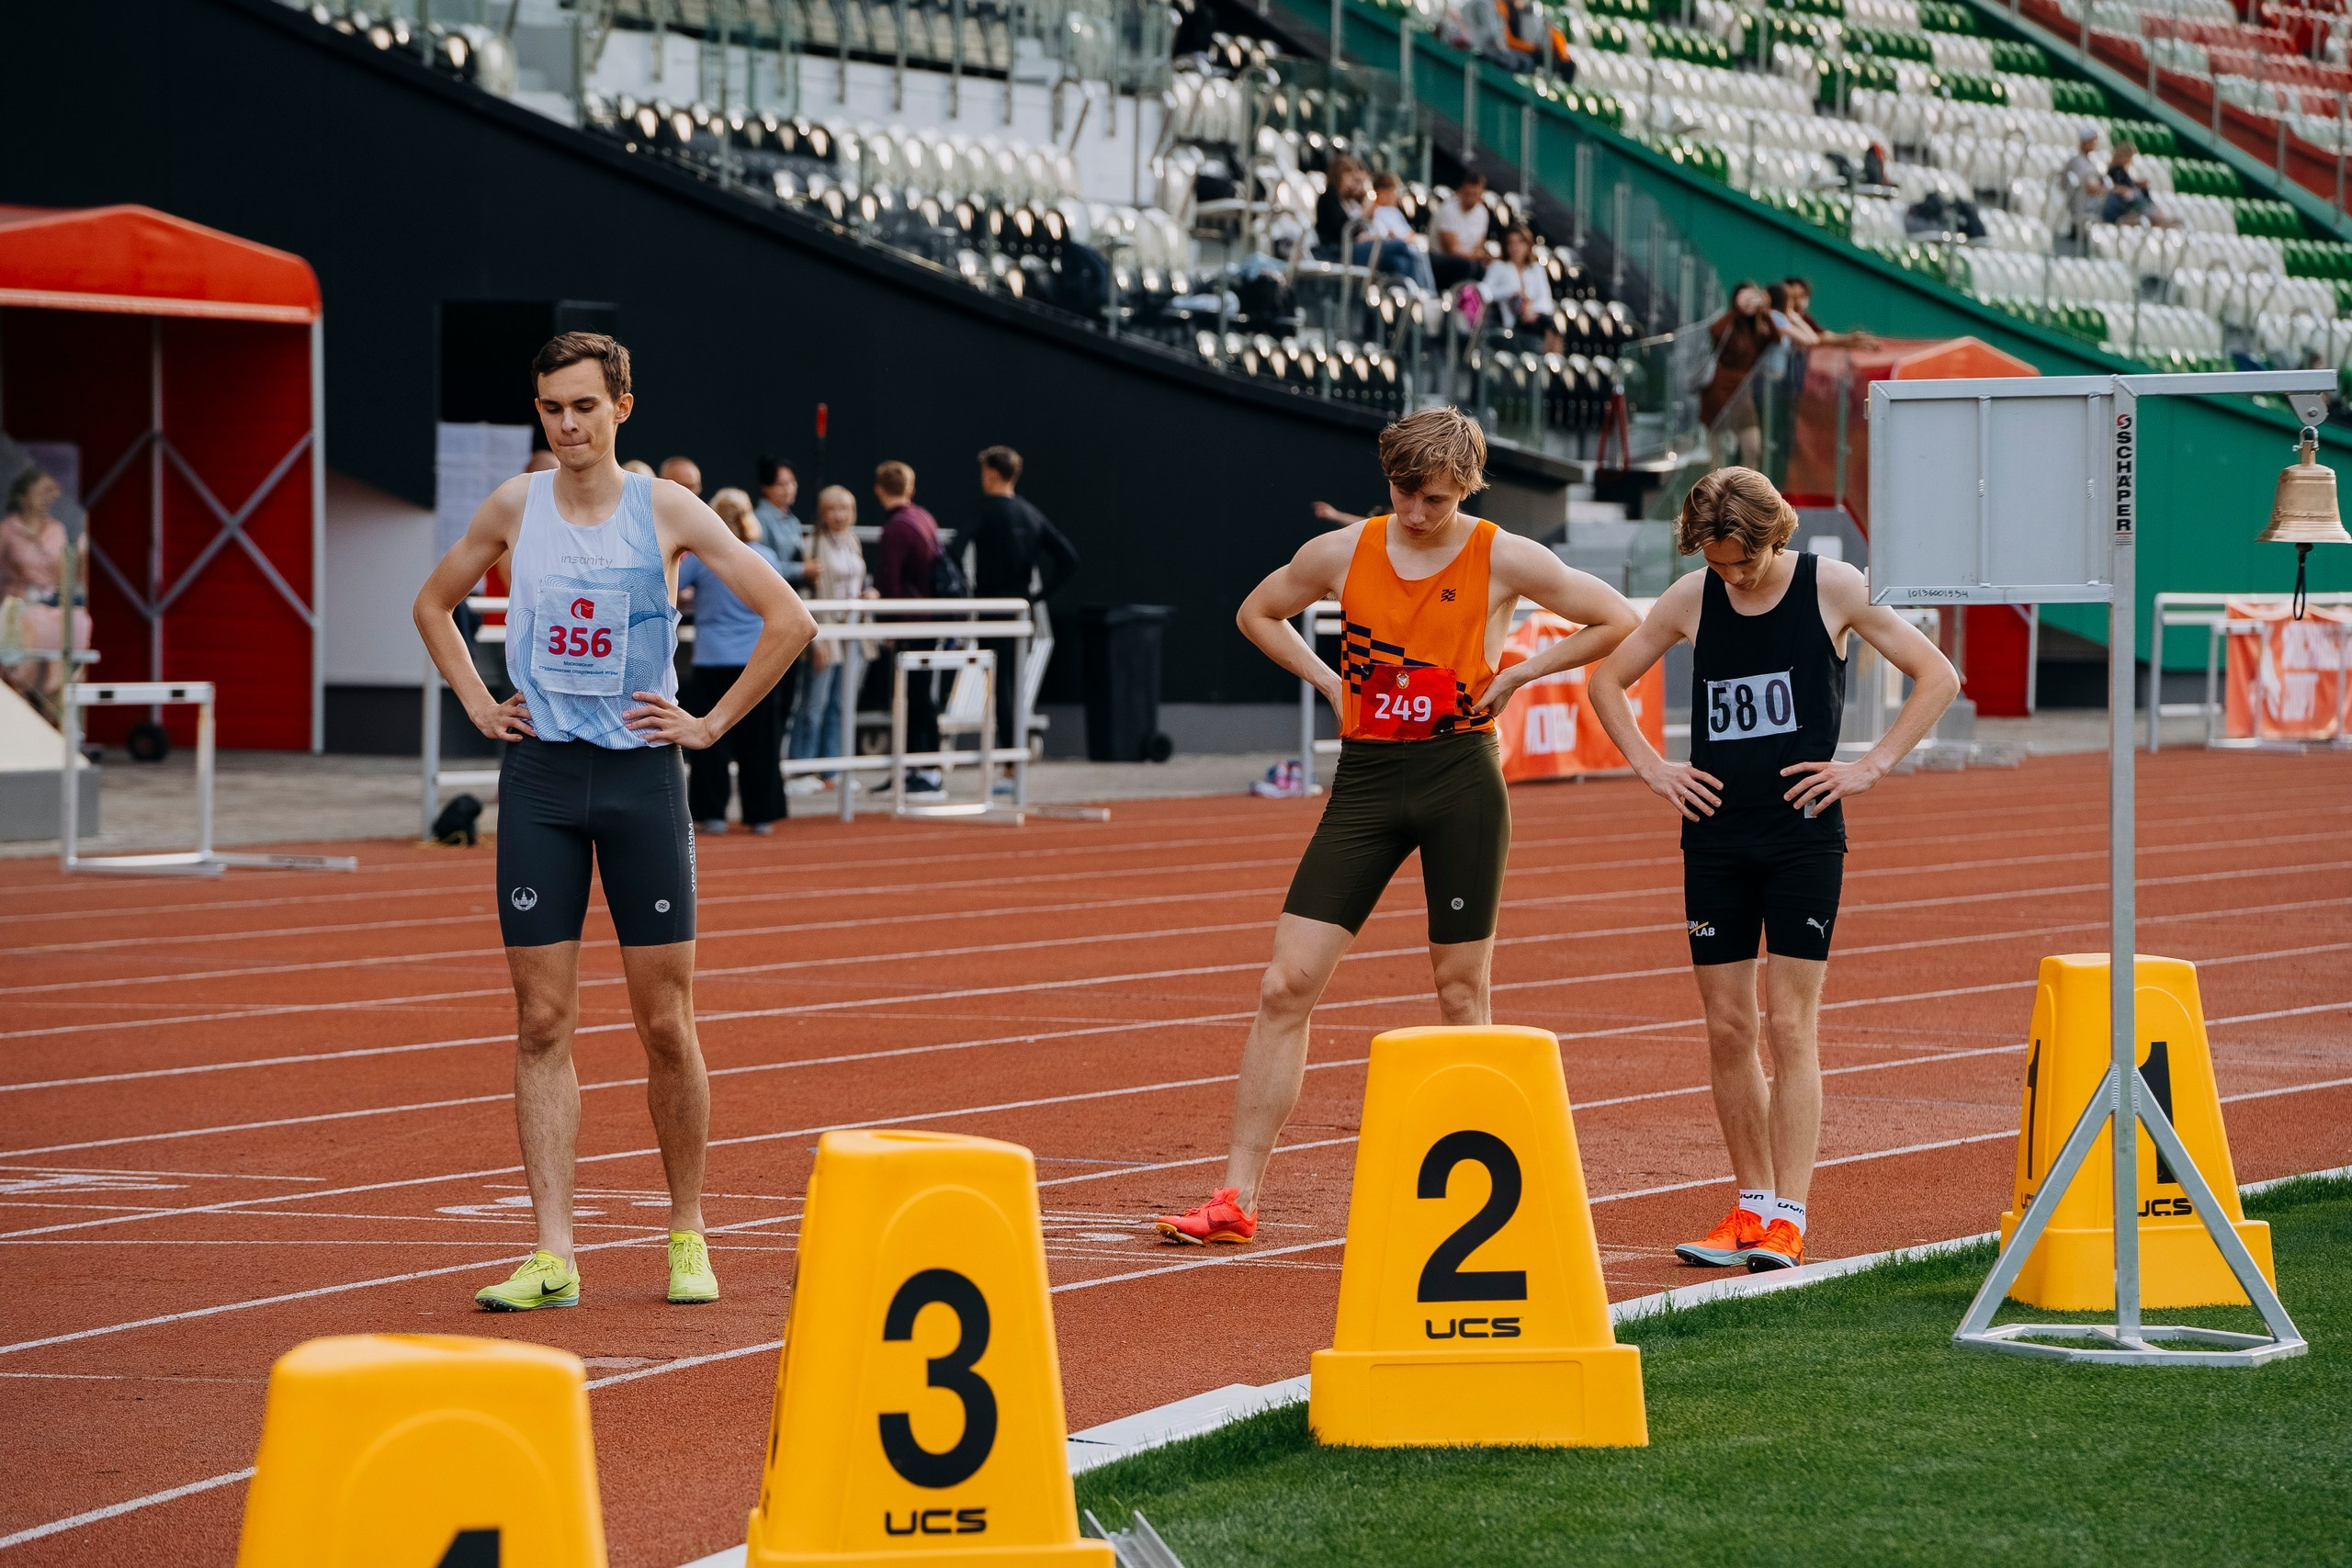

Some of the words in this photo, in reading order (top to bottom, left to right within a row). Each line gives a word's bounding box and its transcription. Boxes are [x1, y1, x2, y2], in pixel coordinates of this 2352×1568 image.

[2116, 431, 2132, 532] SCHÄPER
[560, 552, 614, 569] insanity
[548, 625, 613, 659] 356
[1374, 693, 1432, 722] 249
[1710, 679, 1791, 733] 580
[1695, 927, 1715, 937] LAB
[1417, 1130, 1527, 1303] 2
[1425, 1317, 1521, 1339] UCS
[878, 1268, 999, 1490] 3
[885, 1508, 988, 1536] UCS
